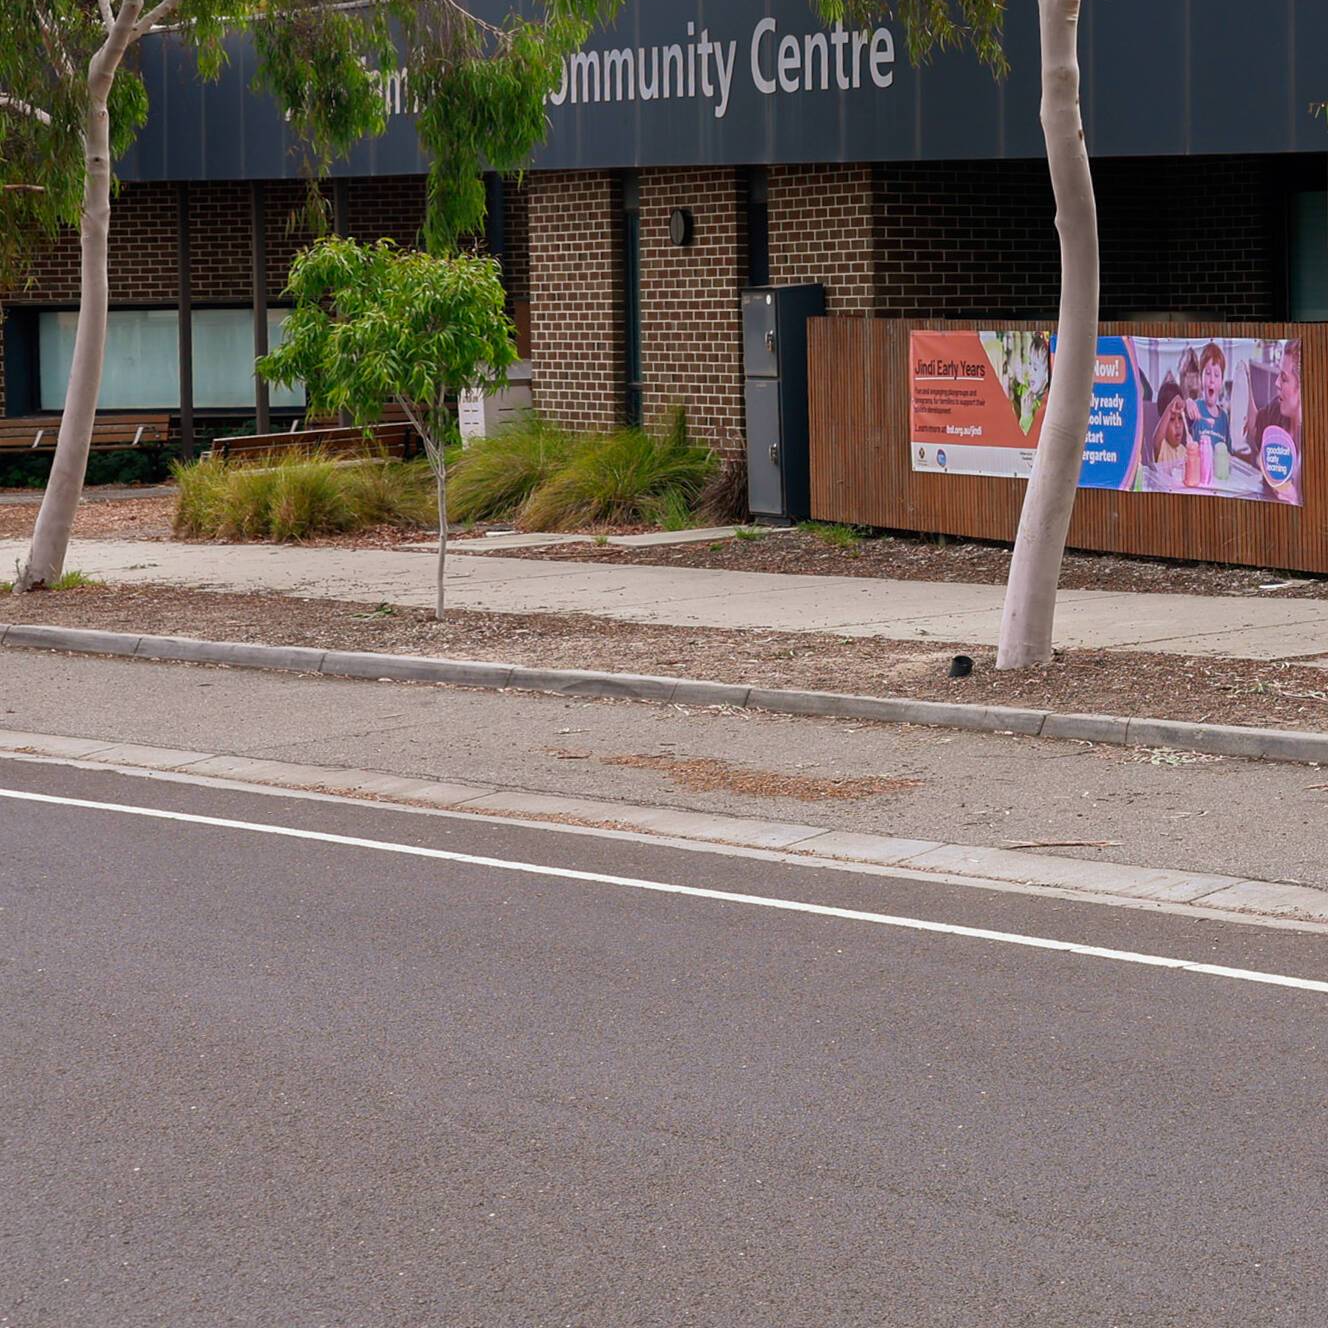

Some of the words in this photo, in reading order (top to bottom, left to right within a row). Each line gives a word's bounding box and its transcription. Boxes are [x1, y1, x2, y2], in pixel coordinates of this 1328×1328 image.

[542, 21, 737, 118] ommunity
[750, 17, 895, 94] Centre
[915, 360, 936, 376] Jindi
[937, 360, 959, 380] Early
[960, 360, 986, 377] Years
[1100, 393, 1124, 411] ready
[1088, 411, 1102, 425] ool
[1103, 411, 1122, 426] with
[1082, 450, 1117, 464] ergarten
